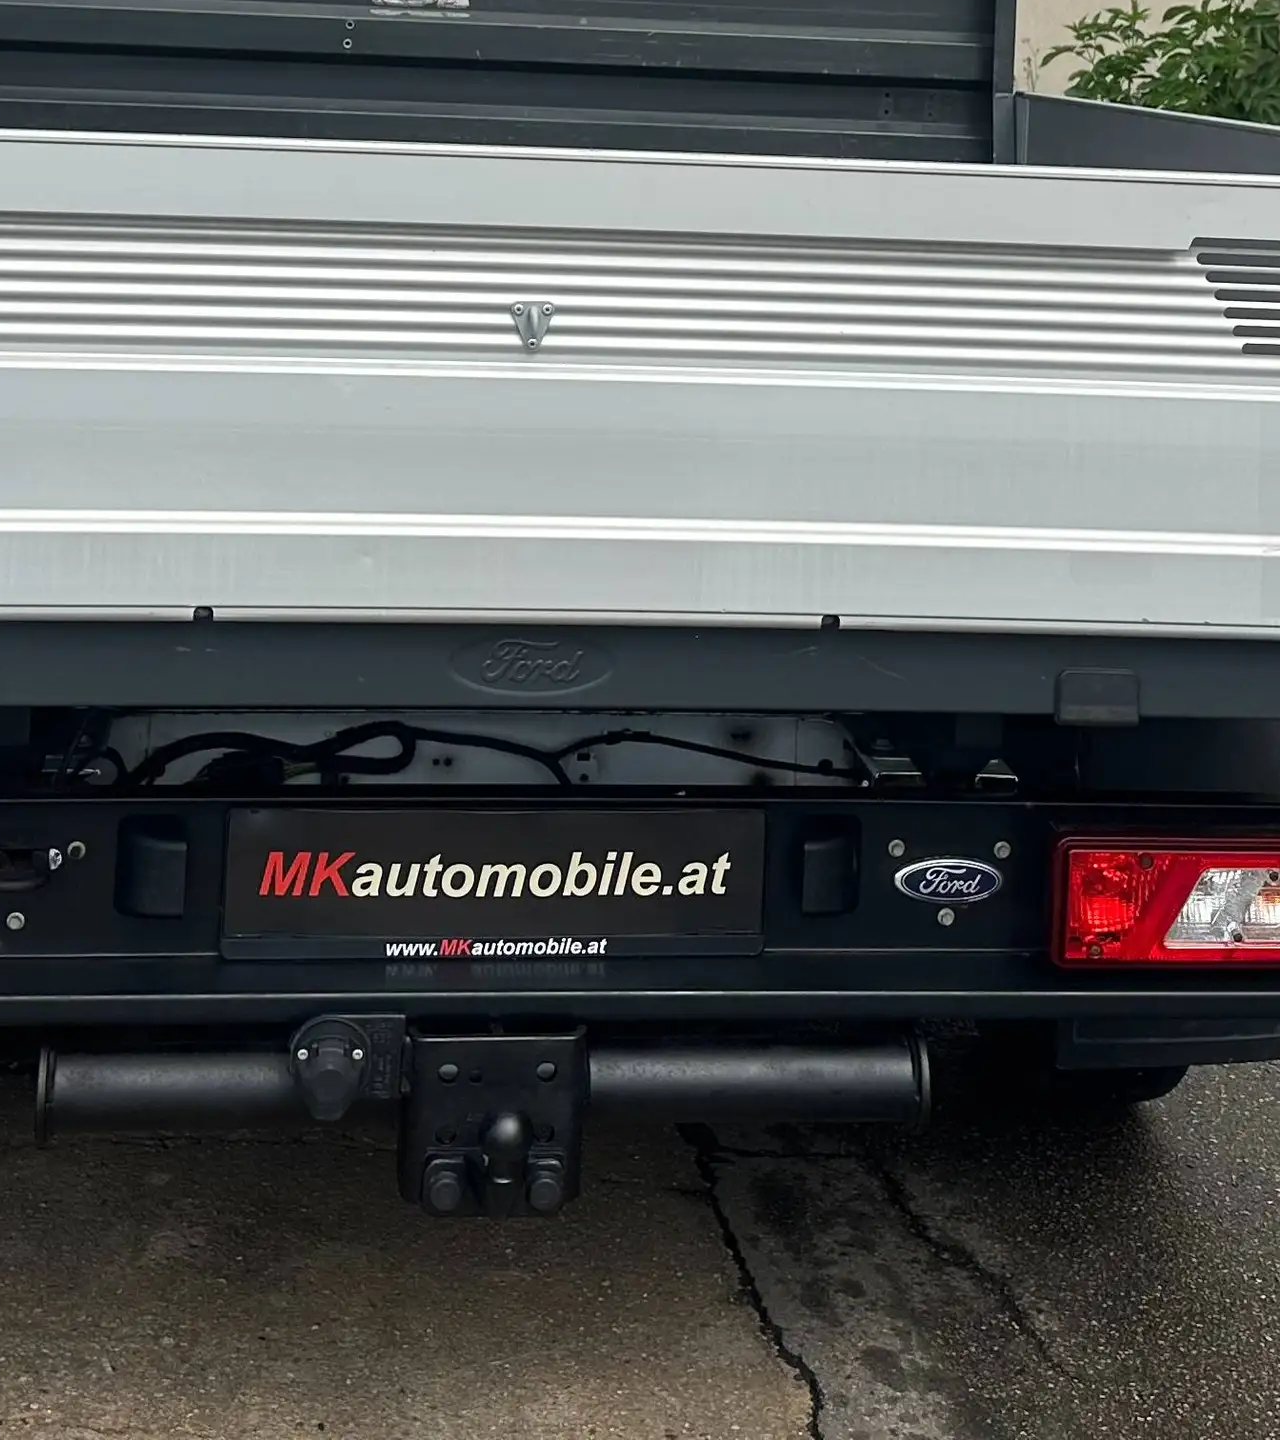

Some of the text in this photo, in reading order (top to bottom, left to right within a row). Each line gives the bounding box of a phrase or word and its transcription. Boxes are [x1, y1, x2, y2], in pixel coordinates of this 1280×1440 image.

[481, 638, 584, 683] Ford
[259, 851, 731, 898] MKautomobile.at
[919, 867, 982, 894] Ford
[385, 938, 607, 957] www.MKautomobile.at
